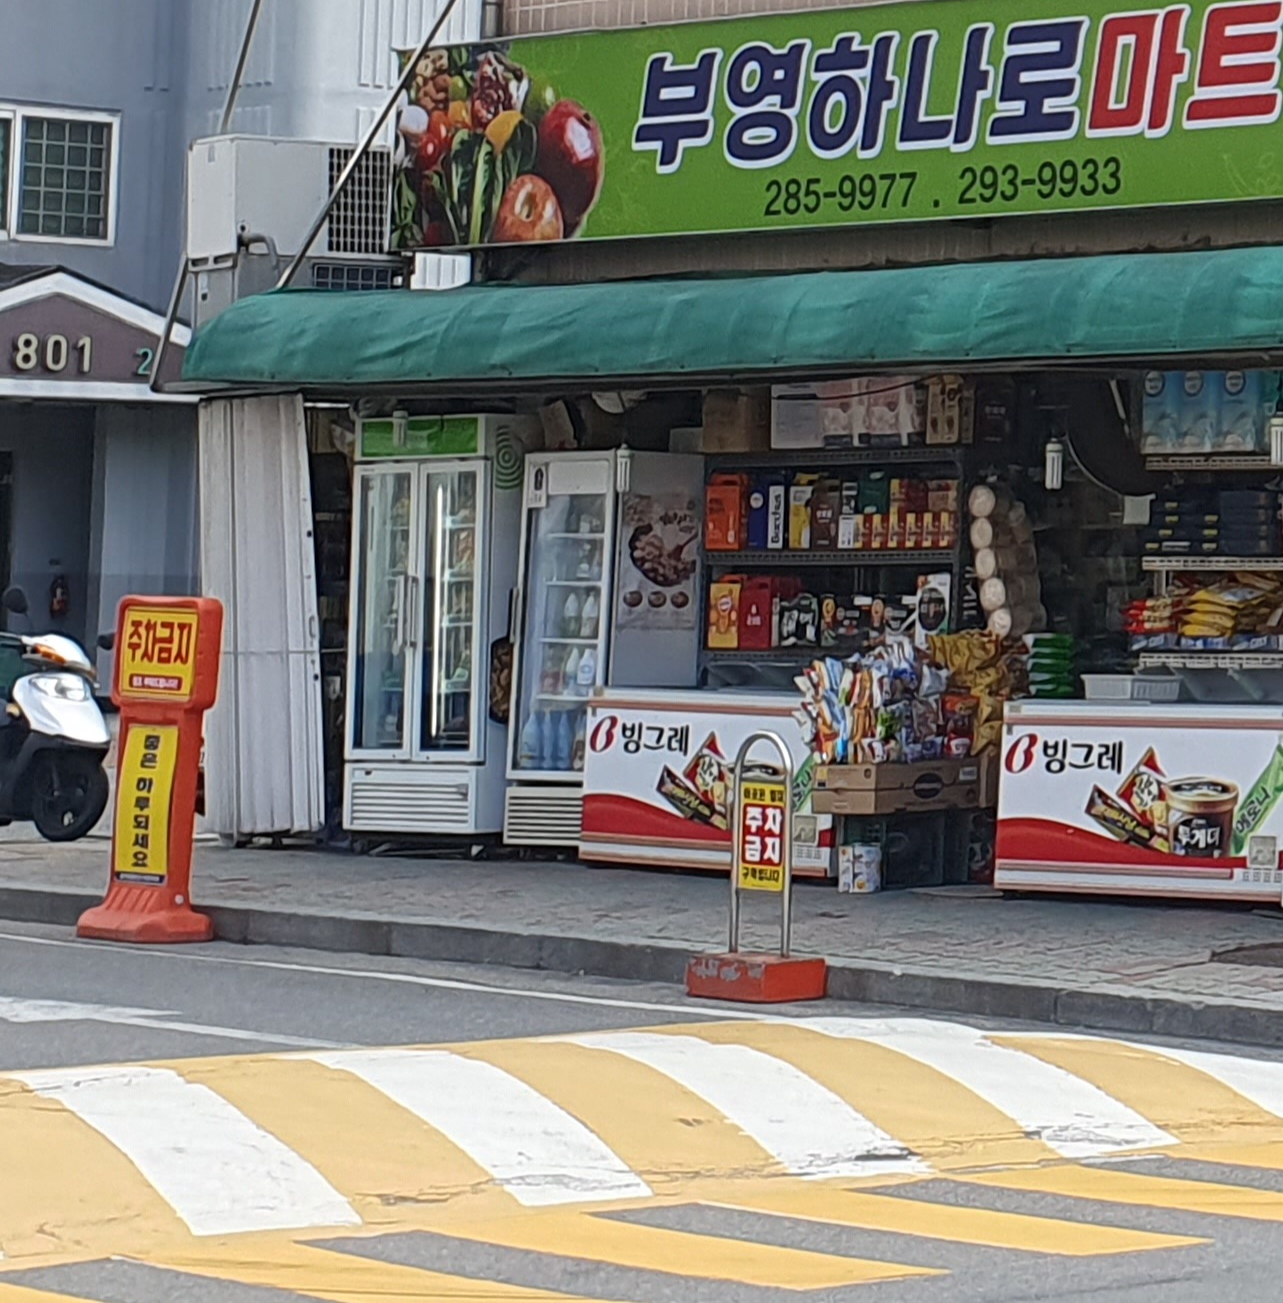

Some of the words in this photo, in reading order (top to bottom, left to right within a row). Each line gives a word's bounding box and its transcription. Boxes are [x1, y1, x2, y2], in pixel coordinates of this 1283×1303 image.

[763, 171, 917, 217] 285-9977
[958, 157, 1122, 205] 293-9933
[15, 333, 94, 374] 801
[127, 618, 193, 666] 주차금지
[621, 721, 690, 757] 빙그레
[1042, 739, 1123, 775] 빙그레
